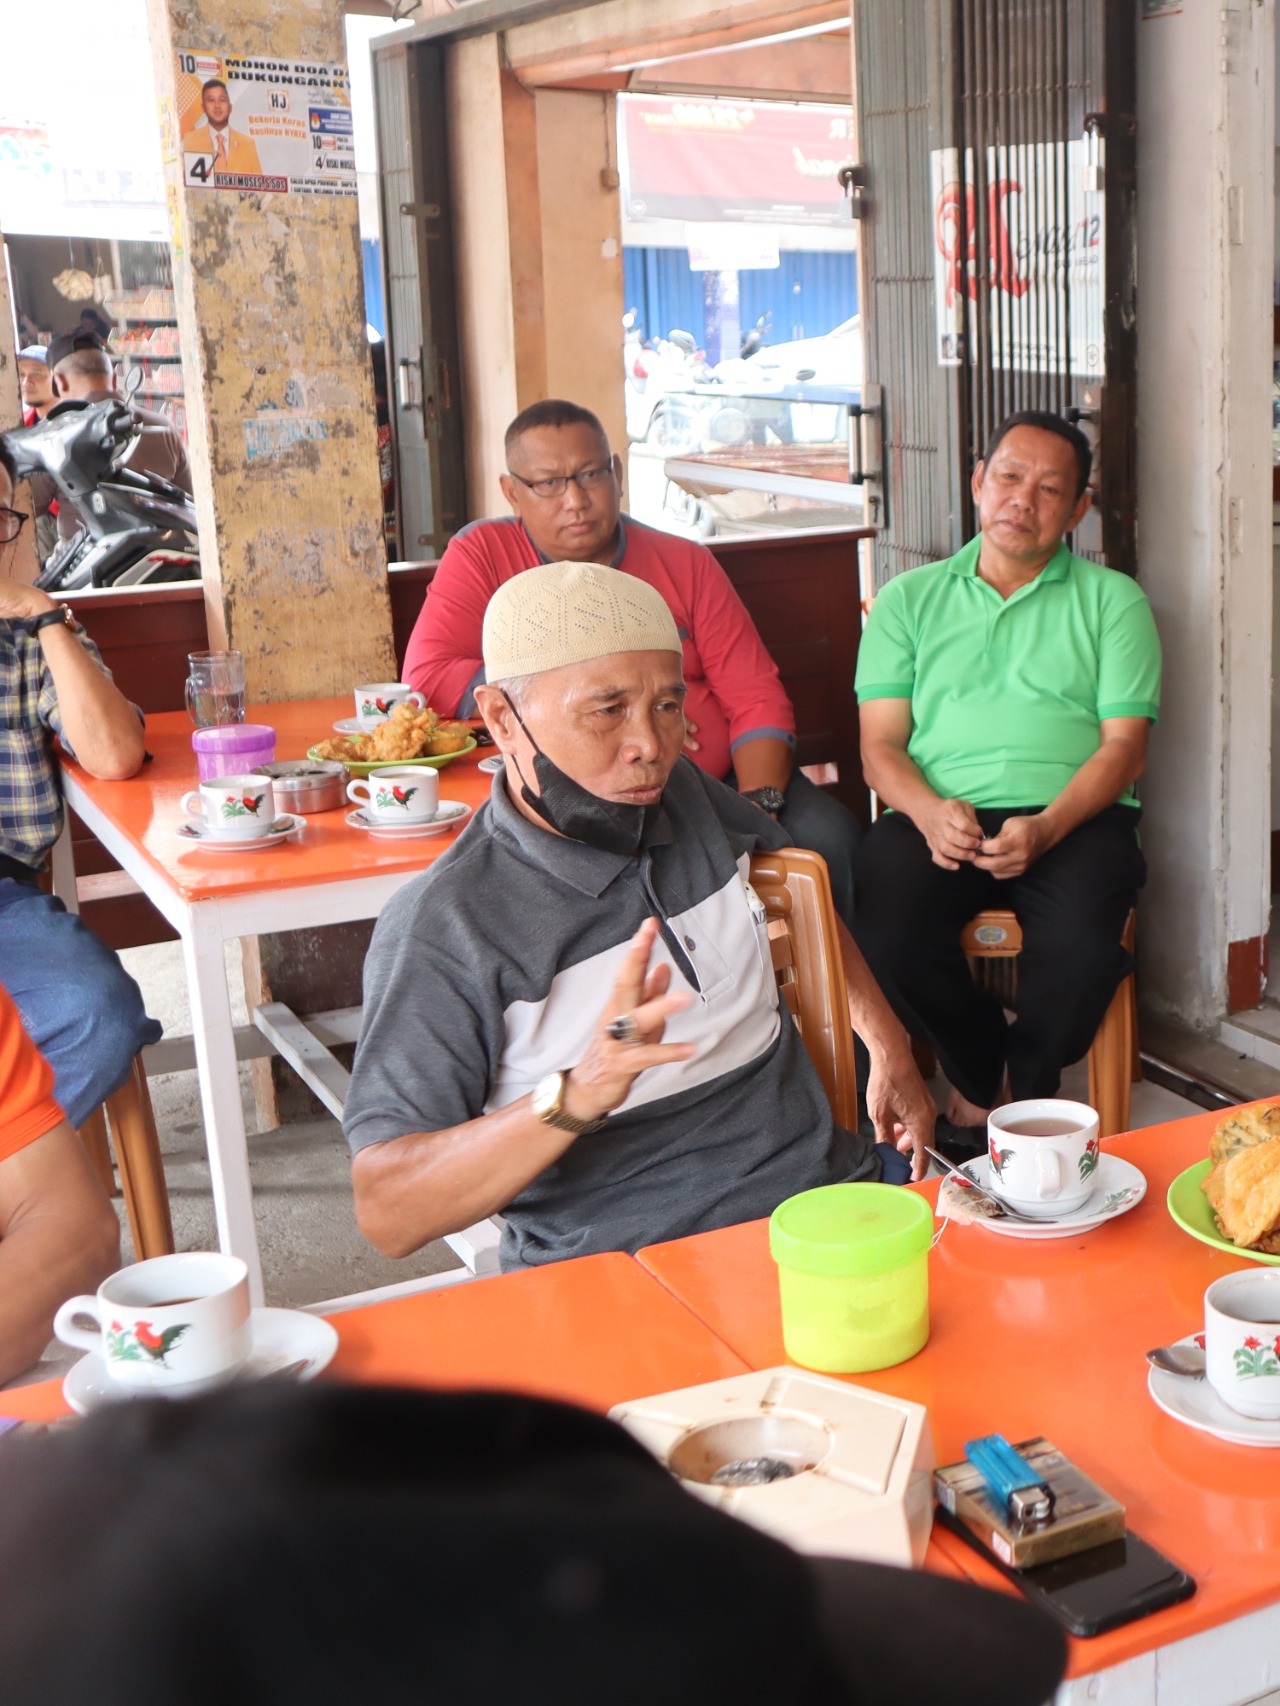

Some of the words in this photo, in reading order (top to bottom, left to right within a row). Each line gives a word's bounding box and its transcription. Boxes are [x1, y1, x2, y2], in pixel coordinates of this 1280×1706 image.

[178, 54, 195, 74] 10
[225, 58, 290, 72] MOHON
[294, 65, 328, 76] DOA
[271, 94, 287, 109] HJ
[312, 134, 322, 150] 10
[190, 157, 208, 183] 4
[316, 156, 323, 169] 4
[216, 174, 236, 187] RISKI
